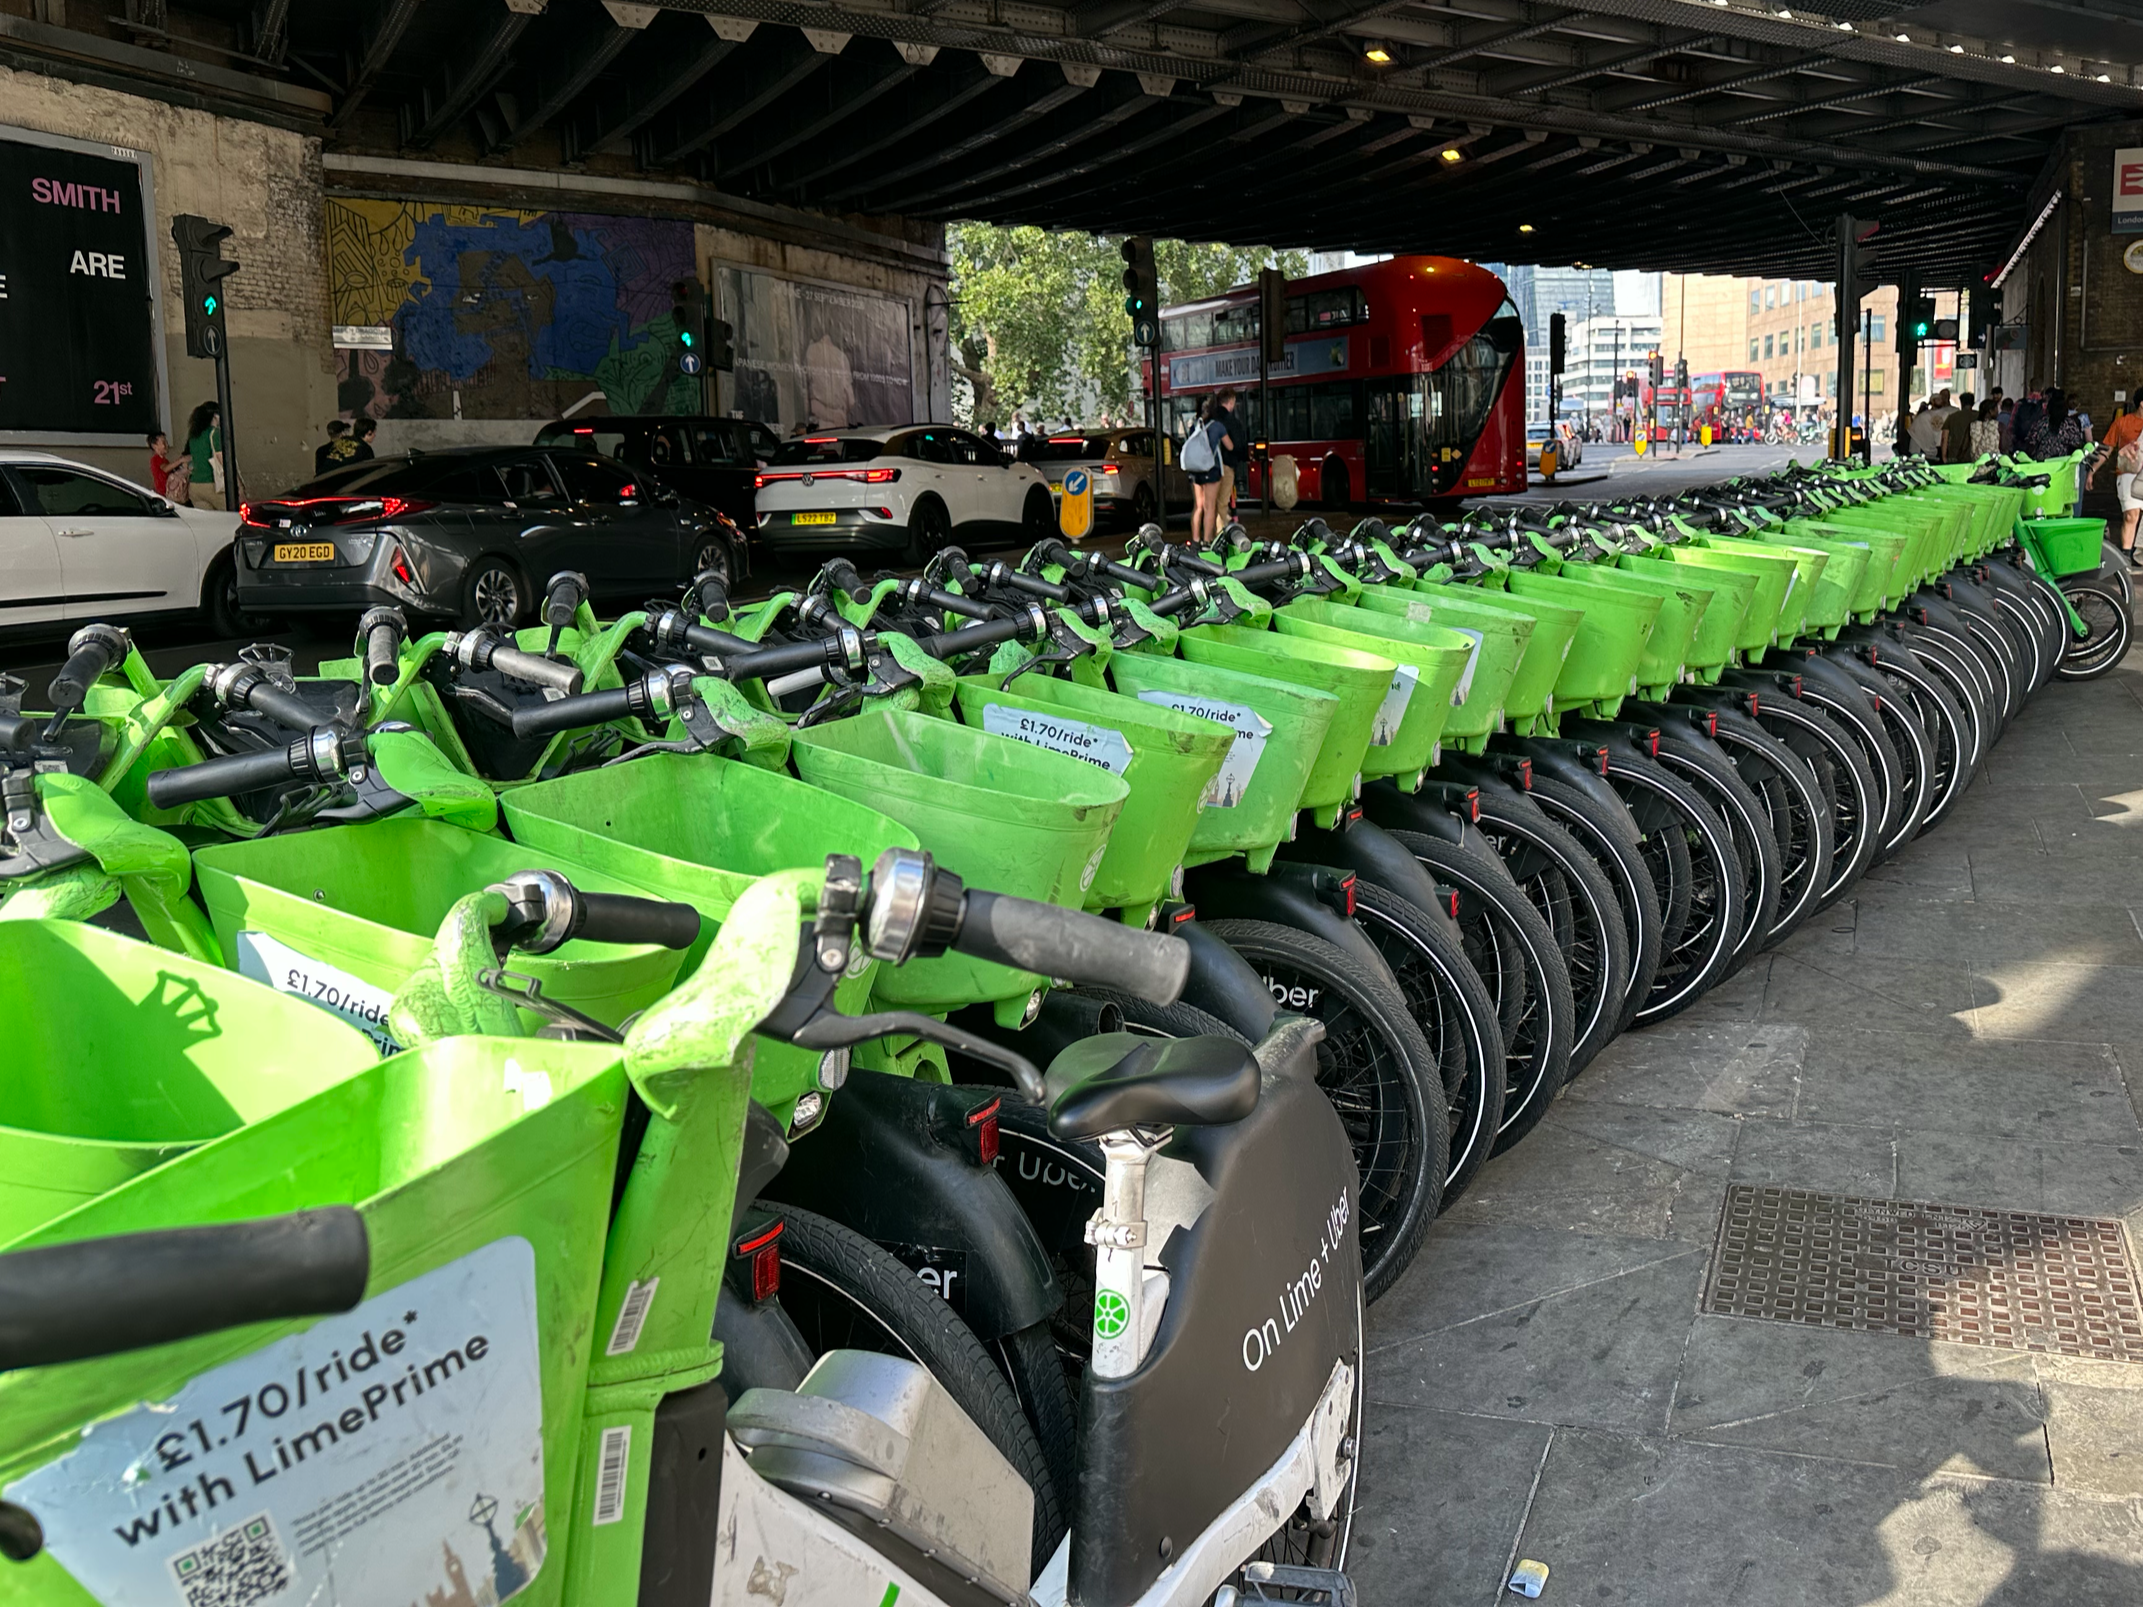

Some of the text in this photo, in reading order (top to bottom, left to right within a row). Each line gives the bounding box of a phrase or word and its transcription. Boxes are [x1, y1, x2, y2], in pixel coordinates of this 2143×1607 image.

[32, 177, 121, 214] SMITH
[2117, 215, 2143, 225] Londo
[70, 250, 126, 279] ARE
[93, 380, 133, 405] 21st
[280, 545, 330, 559] GY20 EGD
[1263, 976, 1319, 1008] ber
[1019, 1151, 1096, 1193] Ube
[1243, 1318, 1281, 1371] On
[1280, 1258, 1322, 1333] Lime
[1327, 1186, 1350, 1250] Uber
[113, 1467, 236, 1549] with
[246, 1332, 490, 1487] LimePrime
